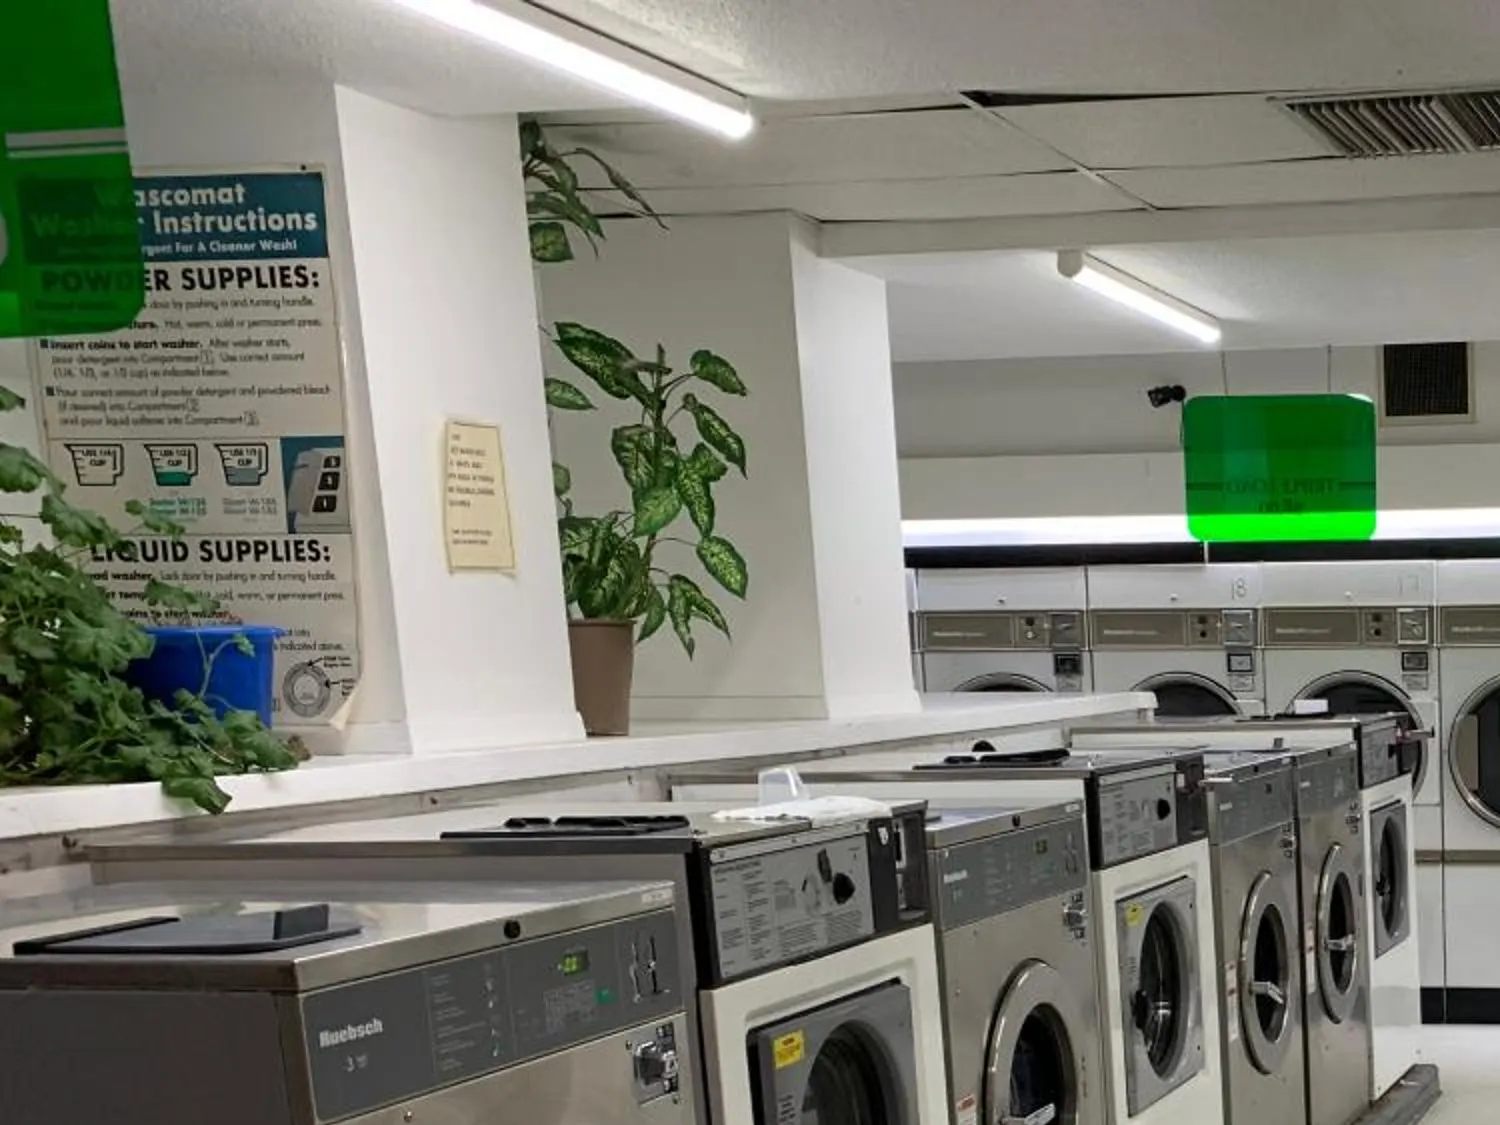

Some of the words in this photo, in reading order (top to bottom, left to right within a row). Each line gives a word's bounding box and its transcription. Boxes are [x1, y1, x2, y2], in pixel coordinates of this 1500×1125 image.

[153, 206, 319, 235] Instructions
[176, 241, 193, 253] For
[197, 241, 207, 252] A
[209, 239, 257, 253] Cleaner
[259, 238, 298, 251] Wash!
[181, 264, 320, 291] SUPPLIES:
[87, 340, 116, 349] coins
[119, 340, 131, 349] to
[133, 338, 158, 349] start
[199, 538, 331, 562] SUPPLIES:
